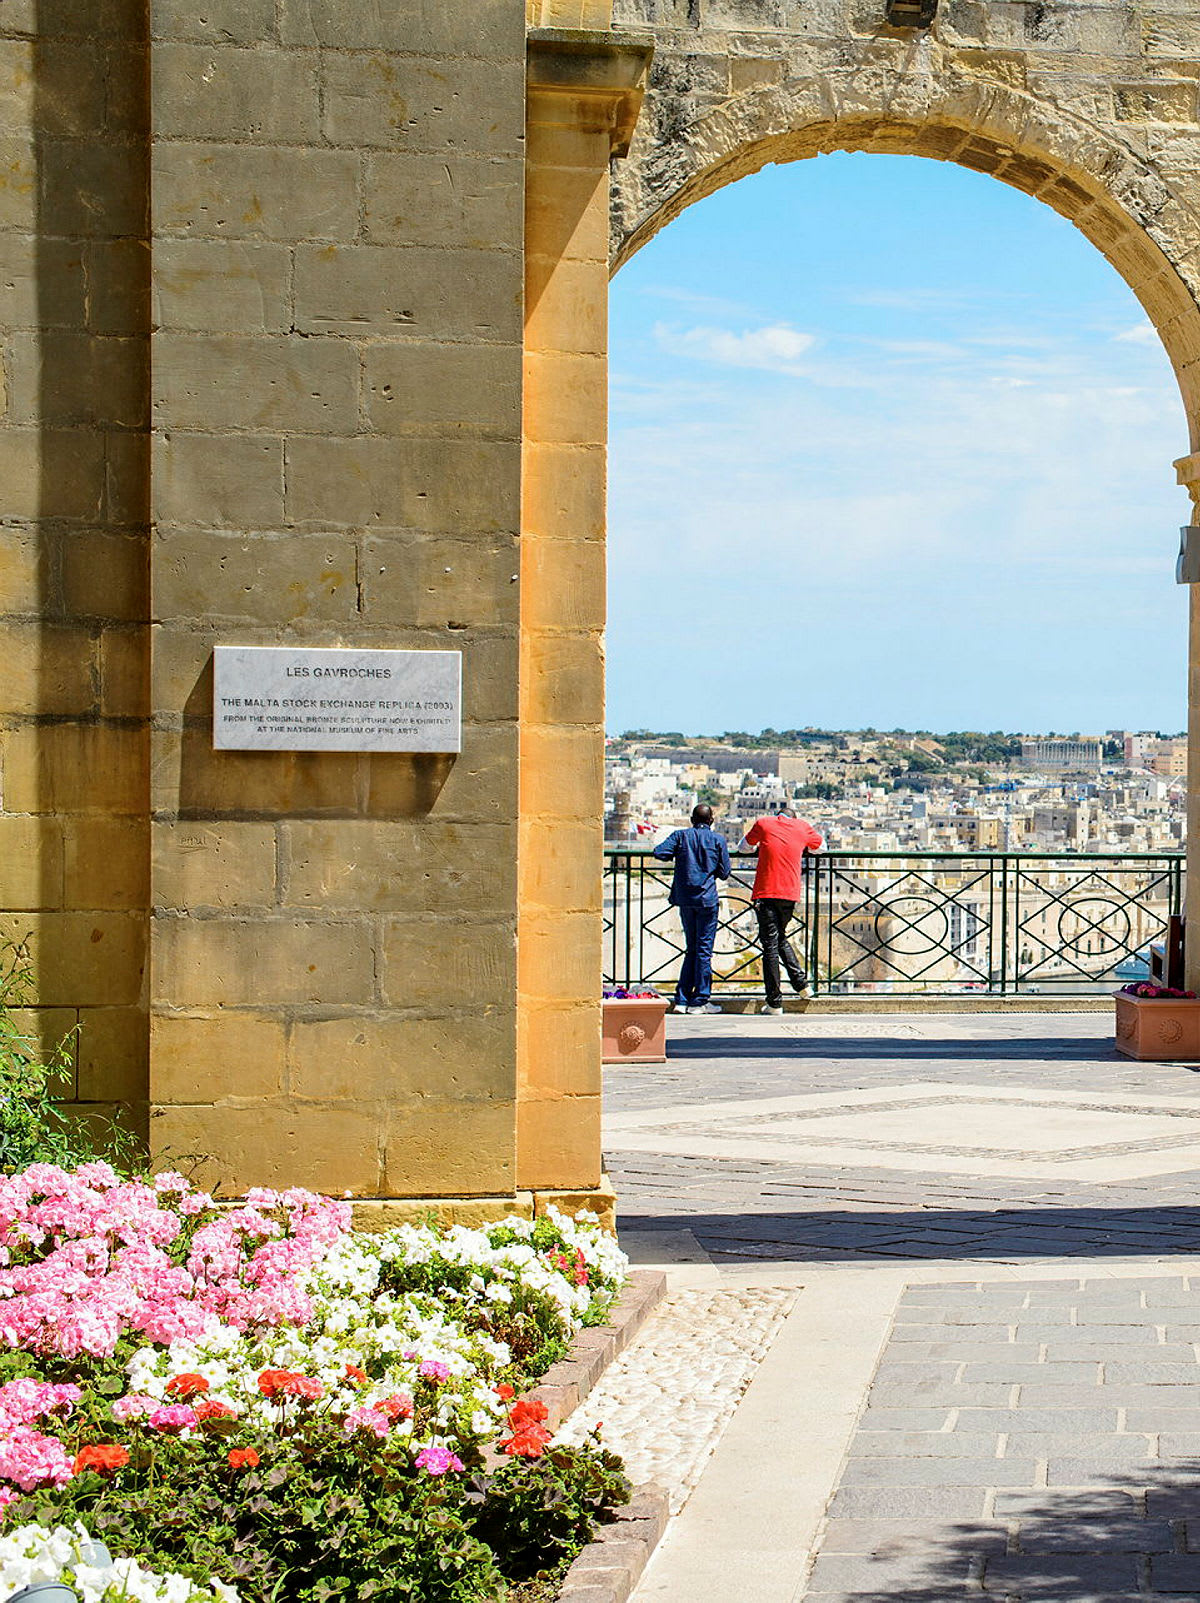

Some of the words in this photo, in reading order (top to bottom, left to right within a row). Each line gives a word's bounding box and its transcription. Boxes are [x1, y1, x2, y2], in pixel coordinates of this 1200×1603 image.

[286, 667, 310, 678] LES
[313, 668, 392, 679] GAVROCHES
[221, 698, 241, 707] THE
[244, 699, 280, 708] MALTA
[282, 700, 318, 709] STOCK
[320, 700, 376, 709] EXCHANGE
[378, 701, 422, 710] REPLICA
[223, 715, 247, 723] FROM
